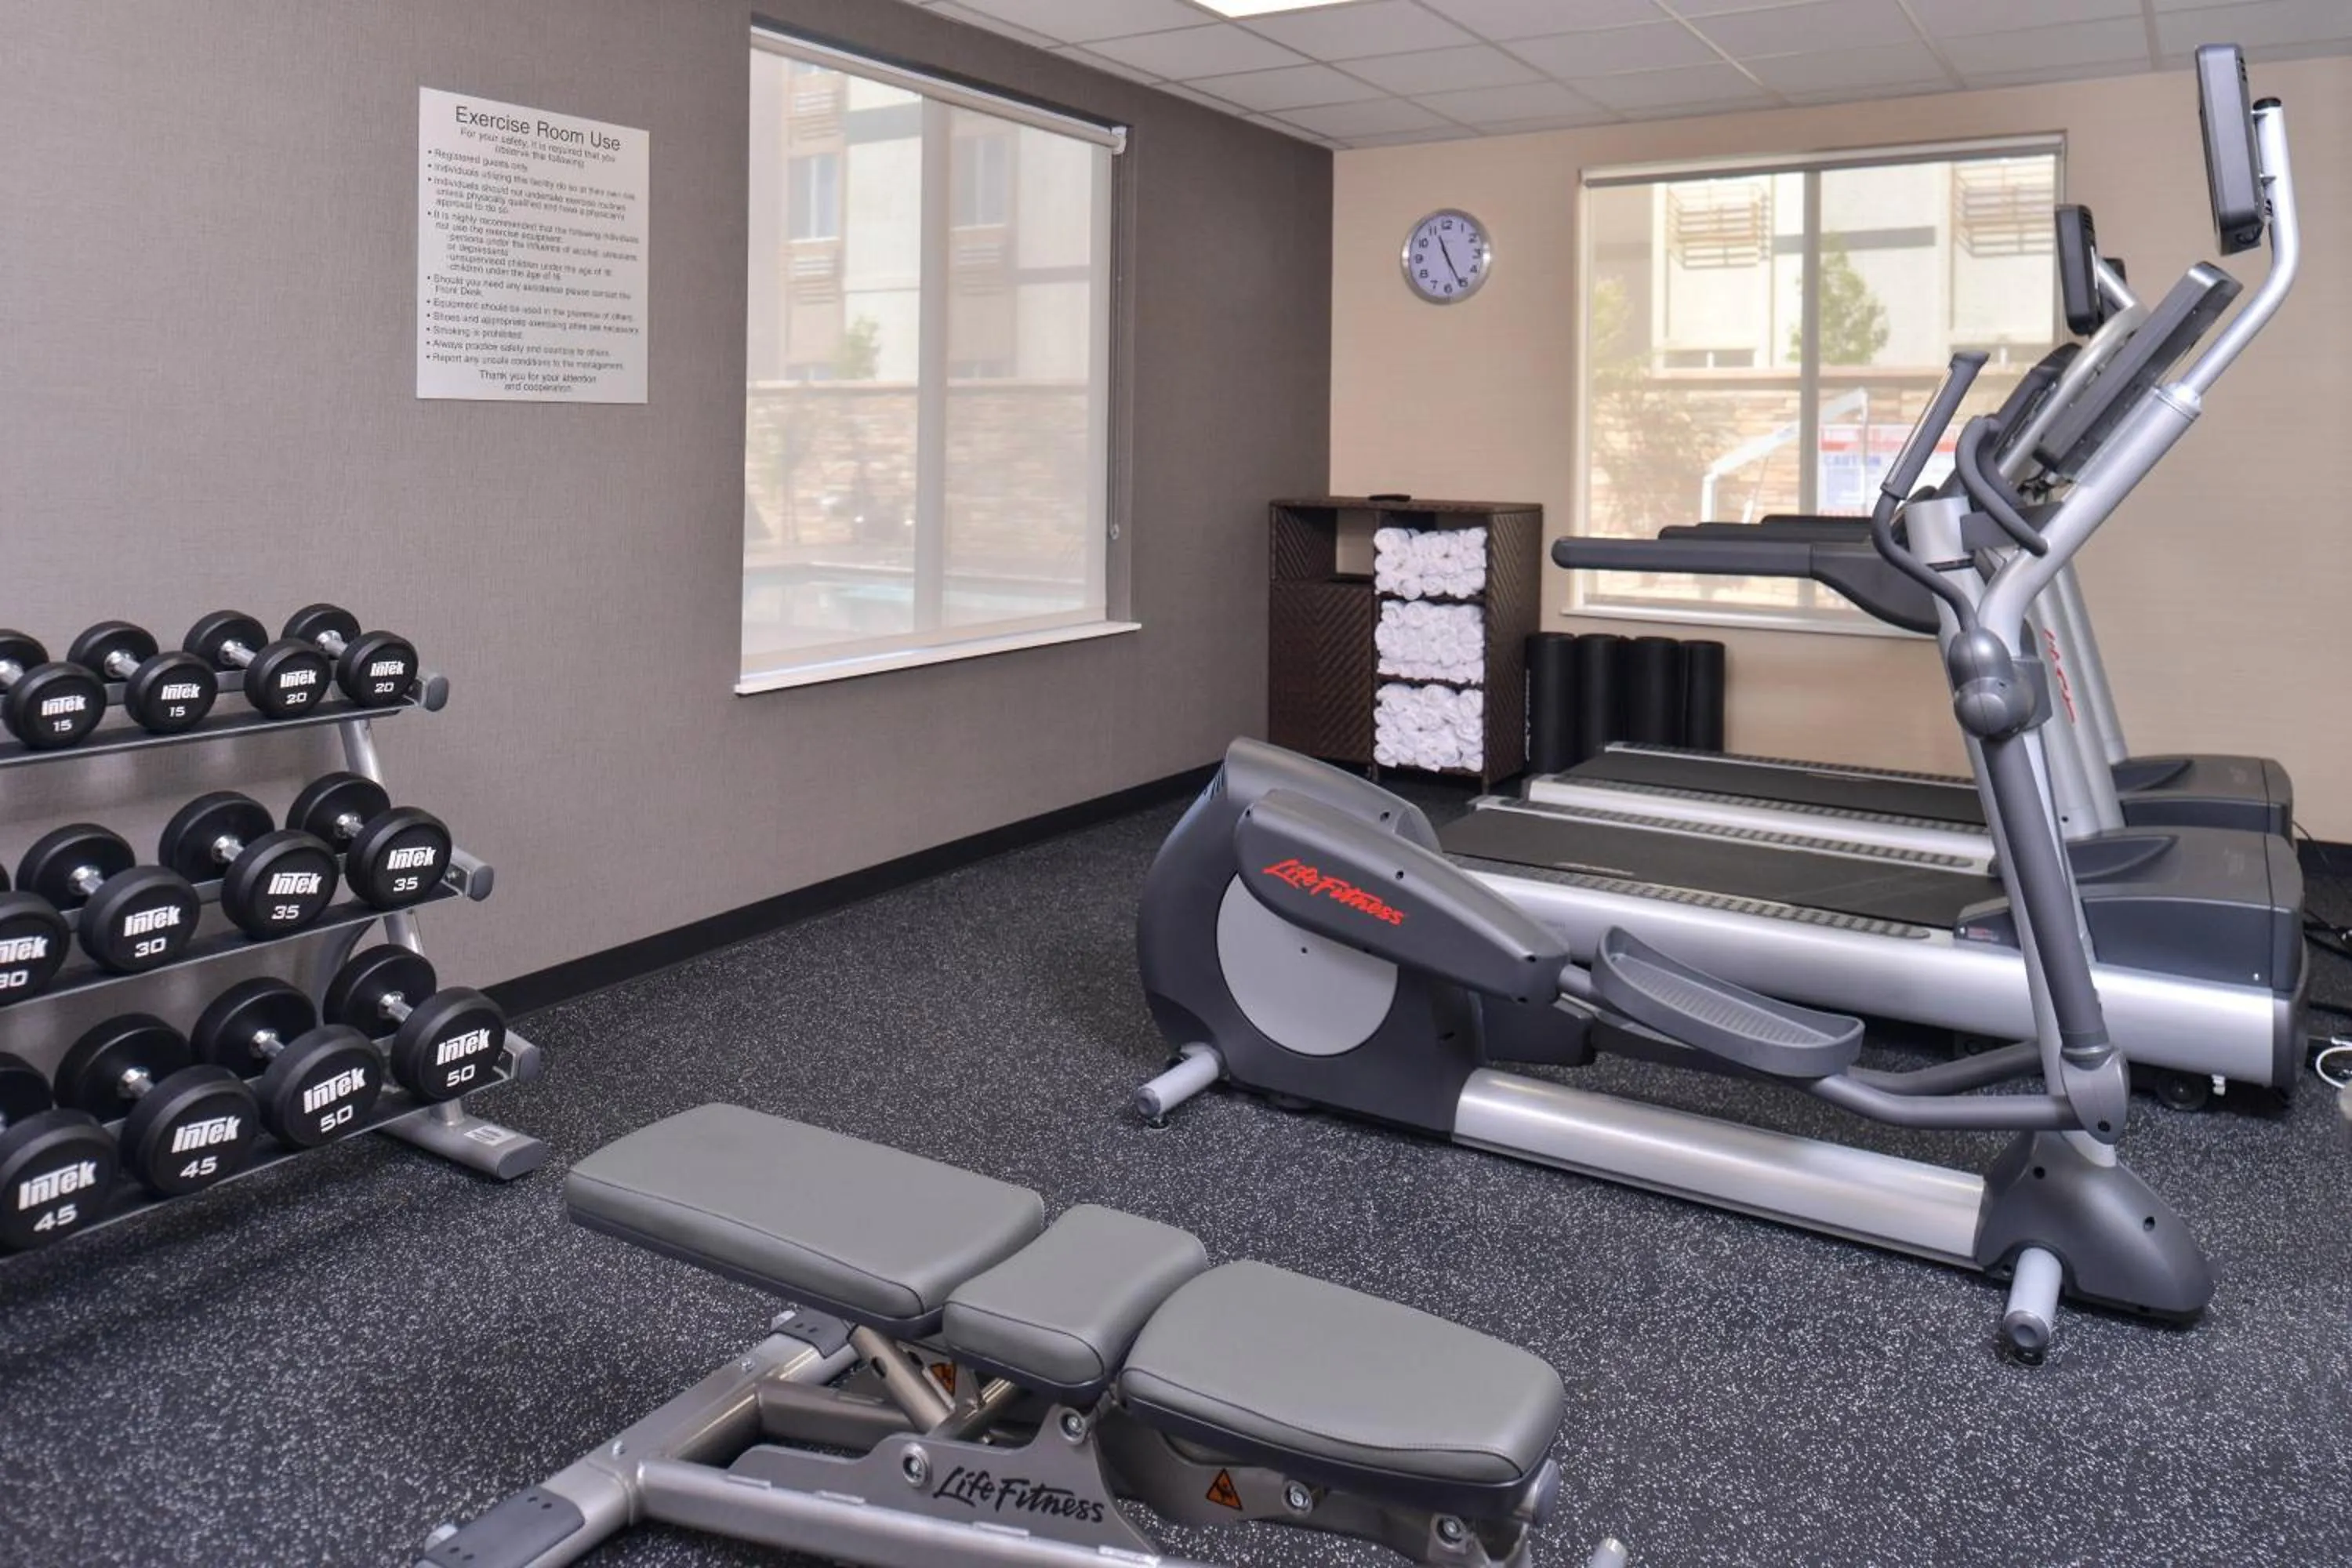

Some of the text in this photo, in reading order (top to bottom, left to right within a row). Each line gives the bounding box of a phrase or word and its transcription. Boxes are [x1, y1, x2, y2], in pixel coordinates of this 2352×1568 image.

[455, 104, 621, 151] Exercise Room Use
[479, 132, 497, 144] your
[584, 150, 599, 159] that
[1428, 225, 1438, 236] 11
[1442, 220, 1453, 230] 12
[1418, 238, 1428, 248] 10
[1468, 233, 1477, 243] 2
[1414, 253, 1424, 263] 9
[1472, 249, 1481, 259] 3
[1419, 269, 1428, 278] 8
[433, 274, 463, 285] Should
[466, 278, 481, 288] you
[483, 278, 503, 288] need
[506, 282, 520, 292] any
[1430, 279, 1439, 289] 7
[1443, 283, 1453, 294] 6
[434, 298, 477, 311] Equipment
[433, 325, 470, 337] Smoking
[432, 339, 463, 350] Always
[432, 353, 462, 364] Report
[479, 371, 506, 379] Thank
[509, 373, 525, 382] you
[503, 382, 521, 390] and
[370, 661, 405, 677] InTek
[280, 670, 317, 688] InTek
[161, 683, 201, 700] InTek
[374, 682, 394, 693] 20
[42, 695, 86, 716] InTek
[285, 692, 308, 705] 20
[169, 706, 186, 717] 15
[53, 720, 73, 731] 15
[387, 846, 436, 870] InTek
[267, 872, 322, 895] InTek
[393, 877, 419, 891] 35
[1262, 858, 1405, 925] Life Fitness
[271, 905, 299, 920] 35
[123, 905, 181, 938] InTek
[0, 936, 49, 964] nTek
[134, 937, 167, 958] 30
[436, 1028, 491, 1066] InTek
[446, 1064, 476, 1087] 50
[303, 1067, 368, 1114] InTek
[320, 1105, 353, 1134] 50
[171, 1114, 241, 1153] InTek
[180, 1156, 218, 1178] 45
[18, 1160, 97, 1211] InTek
[33, 1204, 78, 1232] 45
[932, 1465, 1105, 1523] Life Fitness
